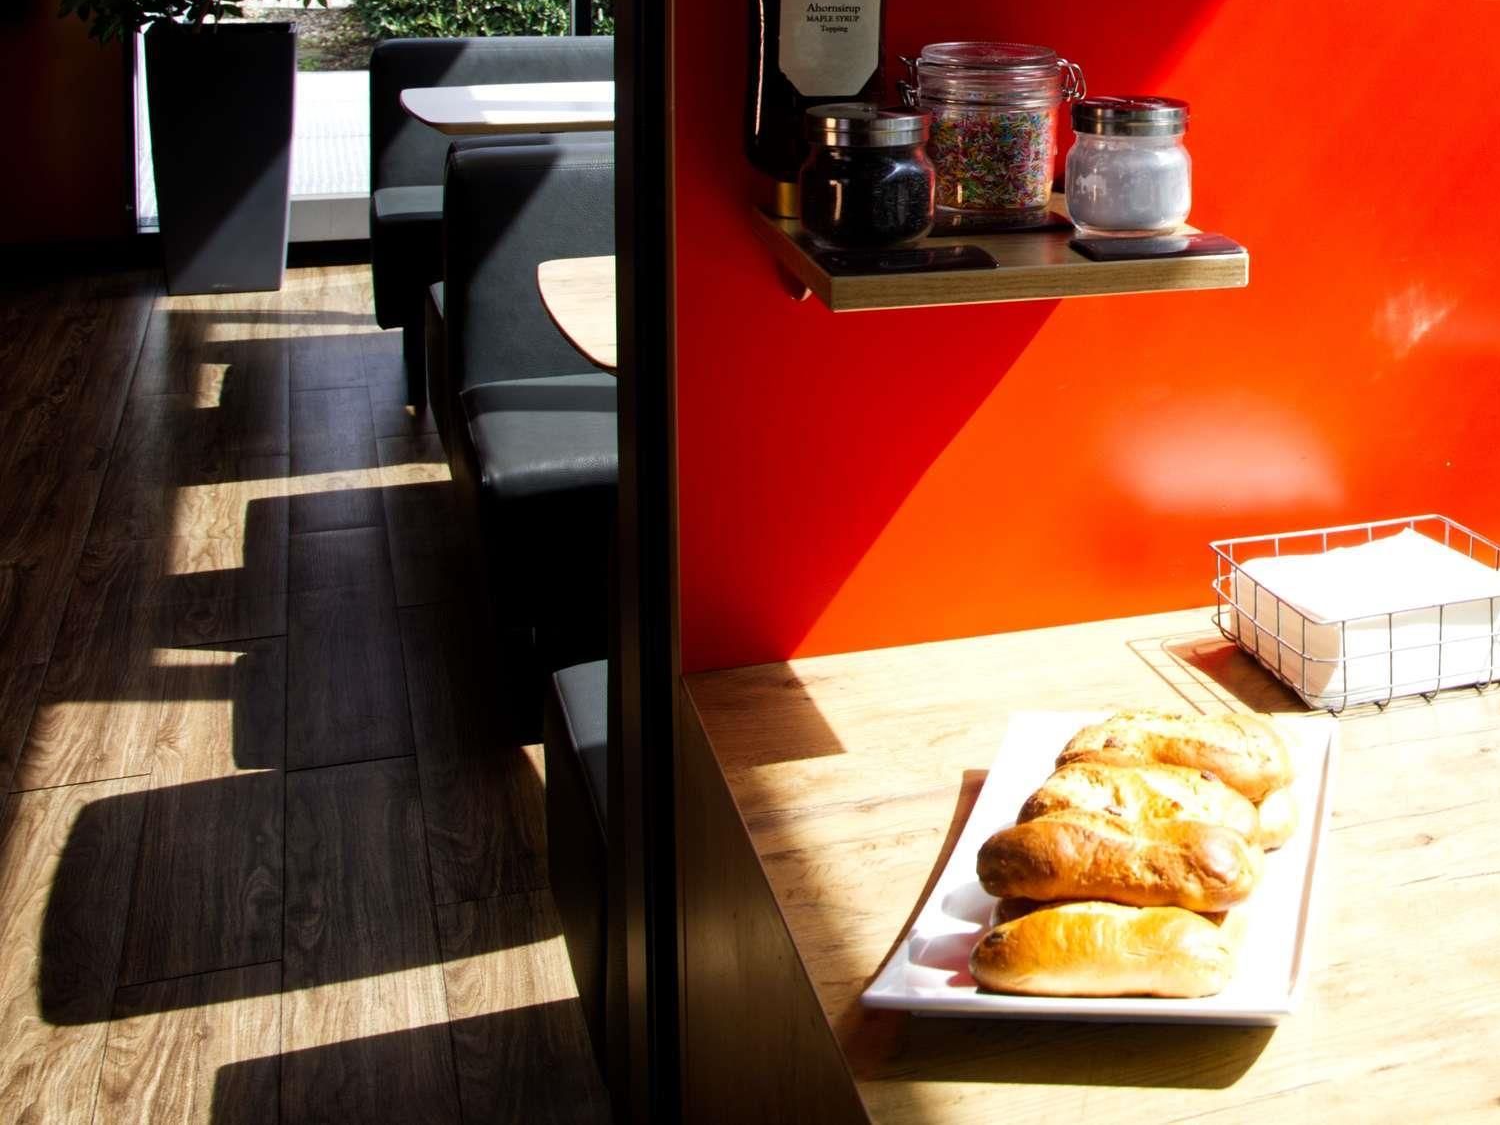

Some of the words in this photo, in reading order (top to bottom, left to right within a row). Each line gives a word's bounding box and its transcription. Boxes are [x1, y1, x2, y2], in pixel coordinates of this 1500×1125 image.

[806, 2, 861, 14] Ahornsirup
[806, 15, 833, 23] MAPLE
[836, 15, 860, 23] SYRUP
